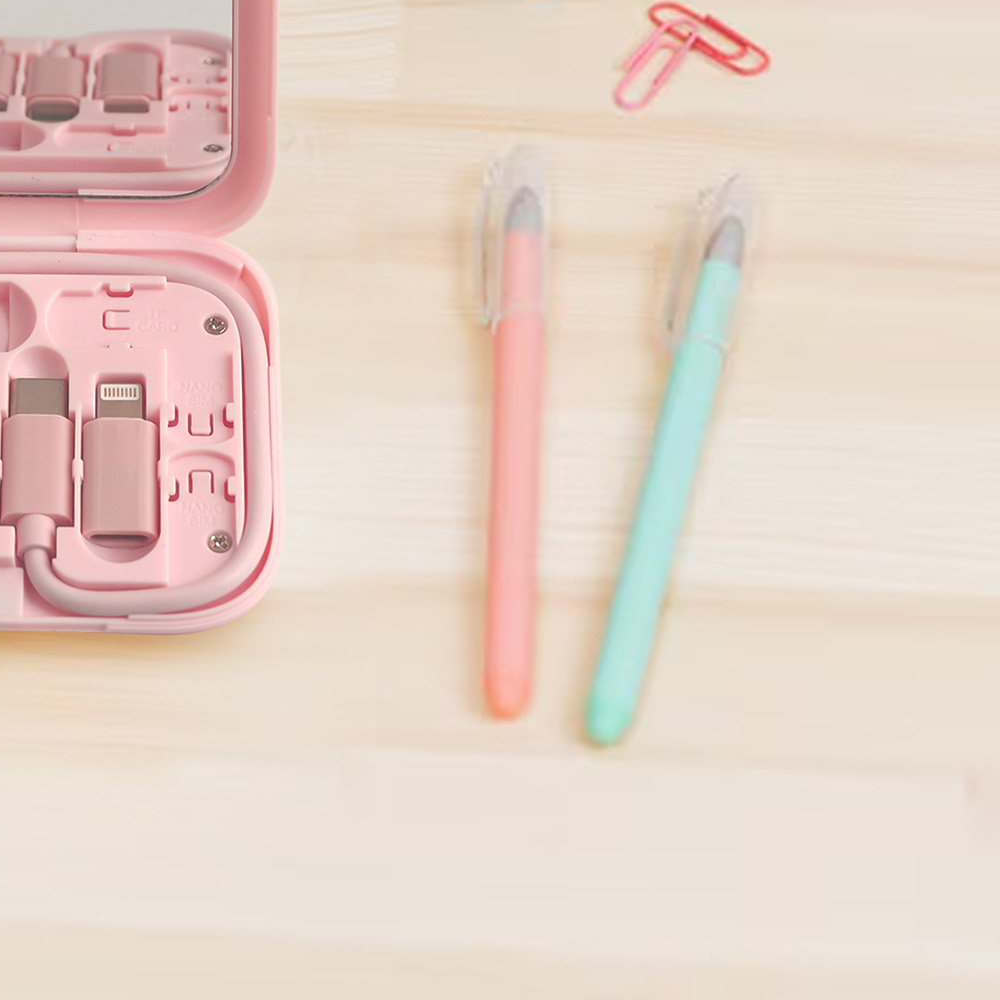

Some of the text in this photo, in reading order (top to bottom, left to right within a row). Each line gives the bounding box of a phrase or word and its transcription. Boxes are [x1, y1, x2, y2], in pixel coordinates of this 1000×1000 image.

[180, 381, 222, 393] NANO
[188, 394, 215, 406] SIM
[181, 501, 223, 514] NANO
[189, 515, 216, 527] SIM
